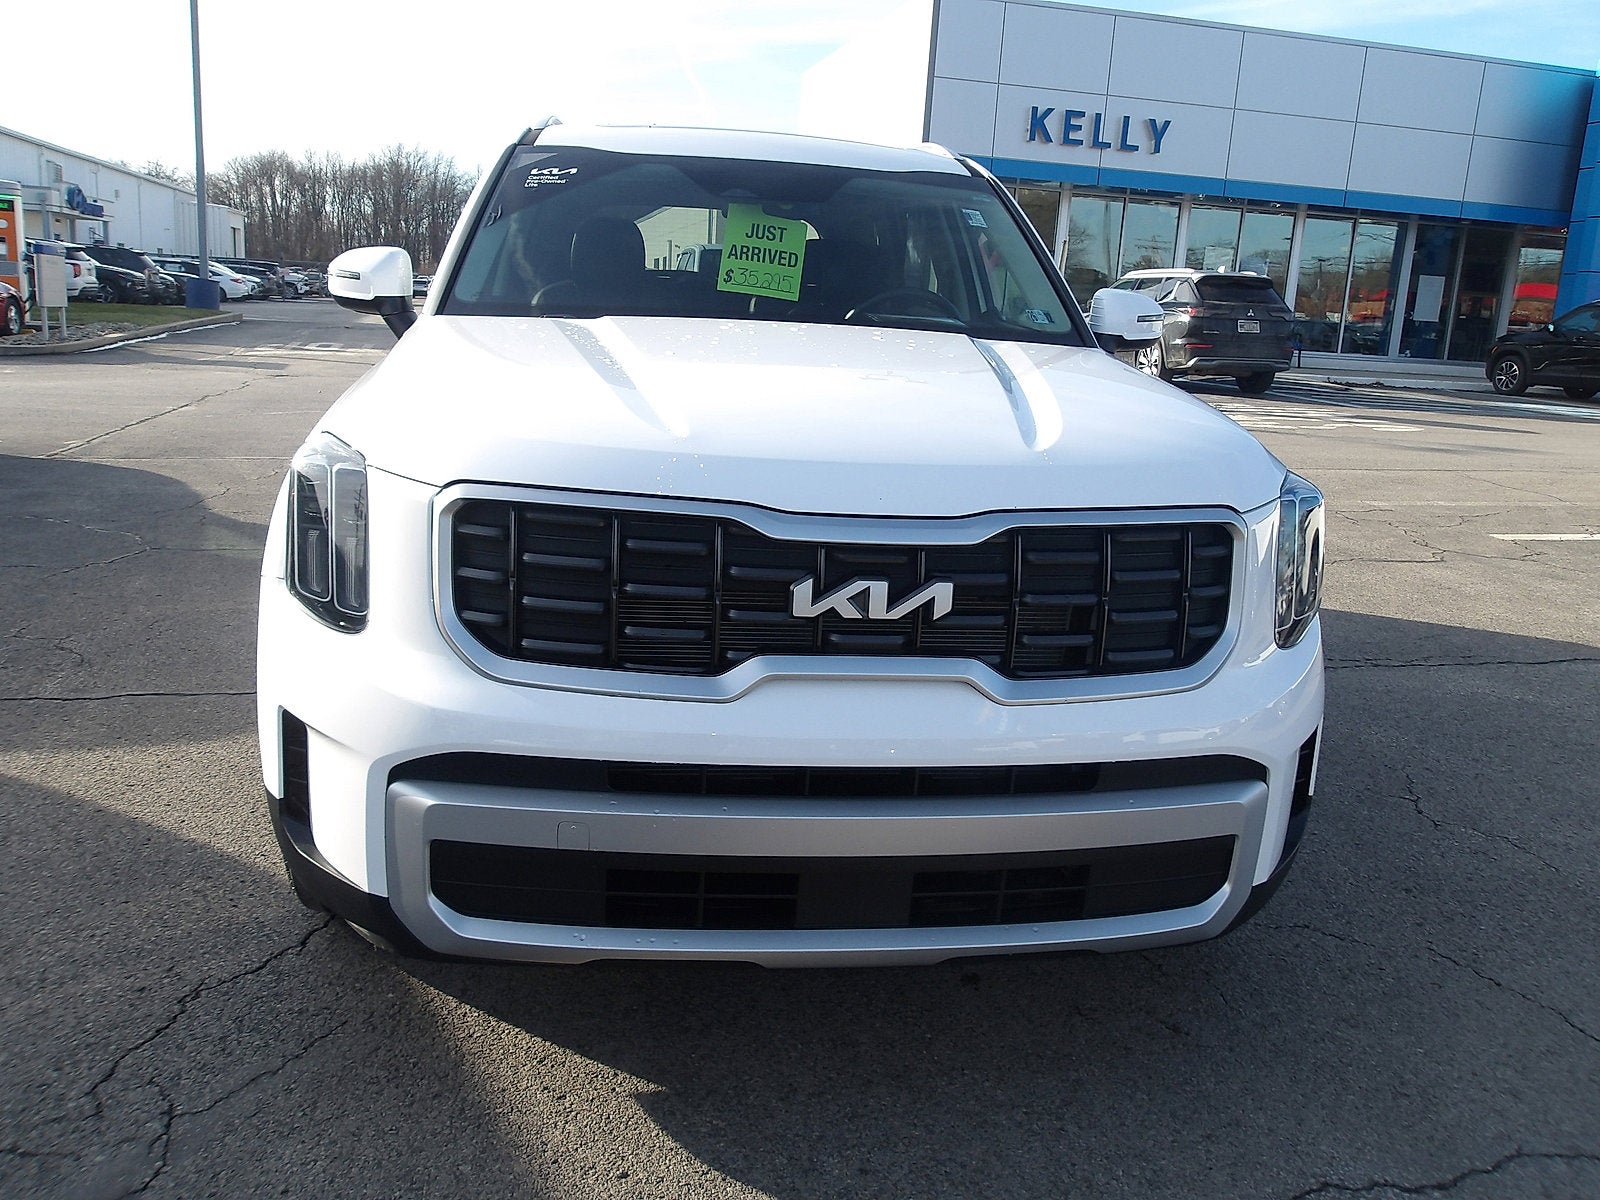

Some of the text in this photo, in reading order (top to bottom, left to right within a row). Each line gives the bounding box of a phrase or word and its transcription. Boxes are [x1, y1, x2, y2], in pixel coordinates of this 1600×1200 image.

[1028, 105, 1172, 155] KELLY
[745, 223, 787, 243] JUST
[727, 244, 799, 268] ARRIVED
[791, 577, 954, 621] KIA
